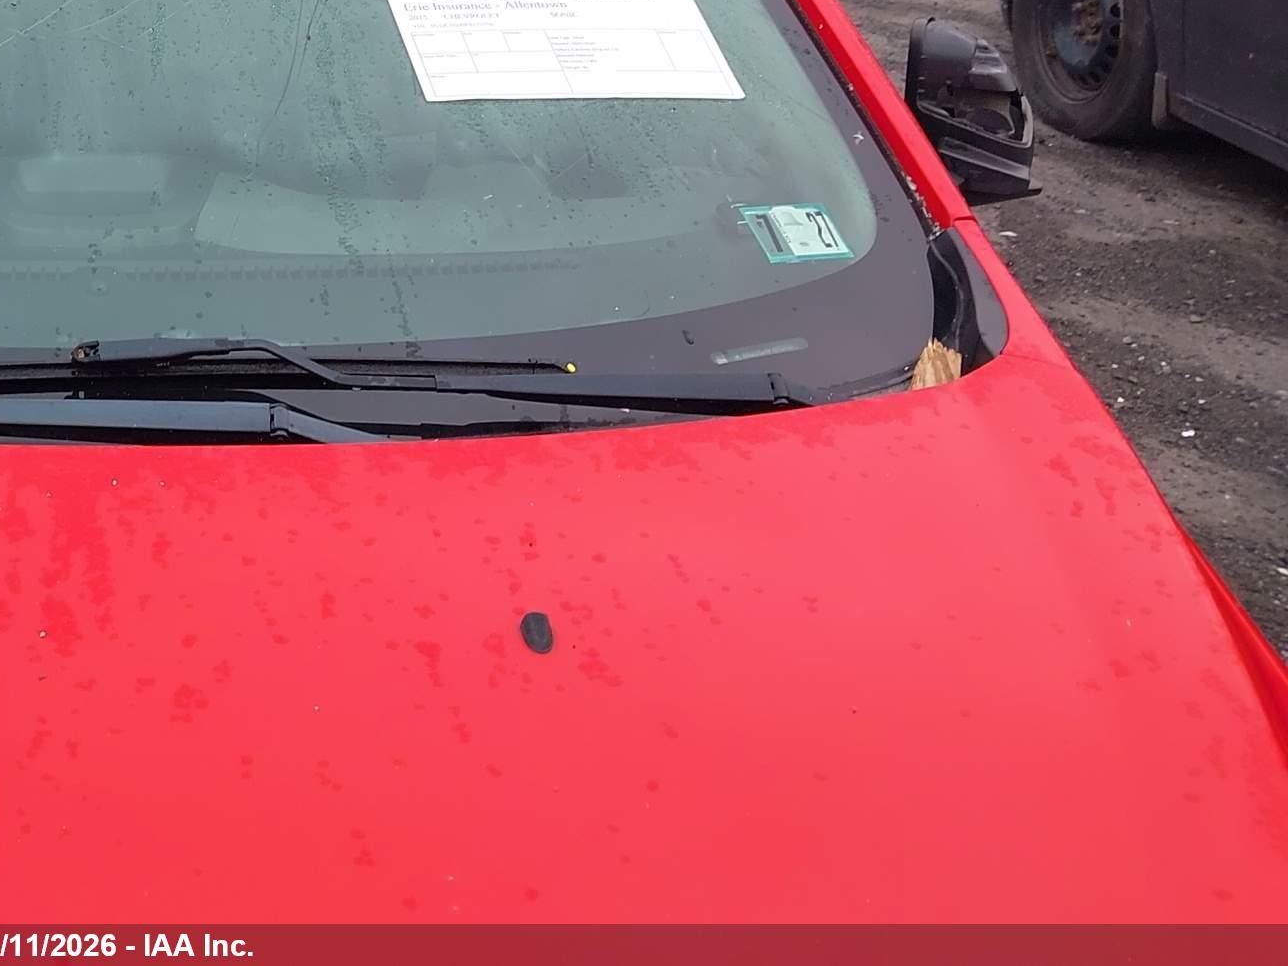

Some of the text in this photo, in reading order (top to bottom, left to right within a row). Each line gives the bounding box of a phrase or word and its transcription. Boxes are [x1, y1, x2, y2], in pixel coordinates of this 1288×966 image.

[404, 2, 429, 13] Erie
[432, 1, 494, 11] Insurance
[503, 0, 568, 11] Allentown
[805, 211, 840, 248] 27
